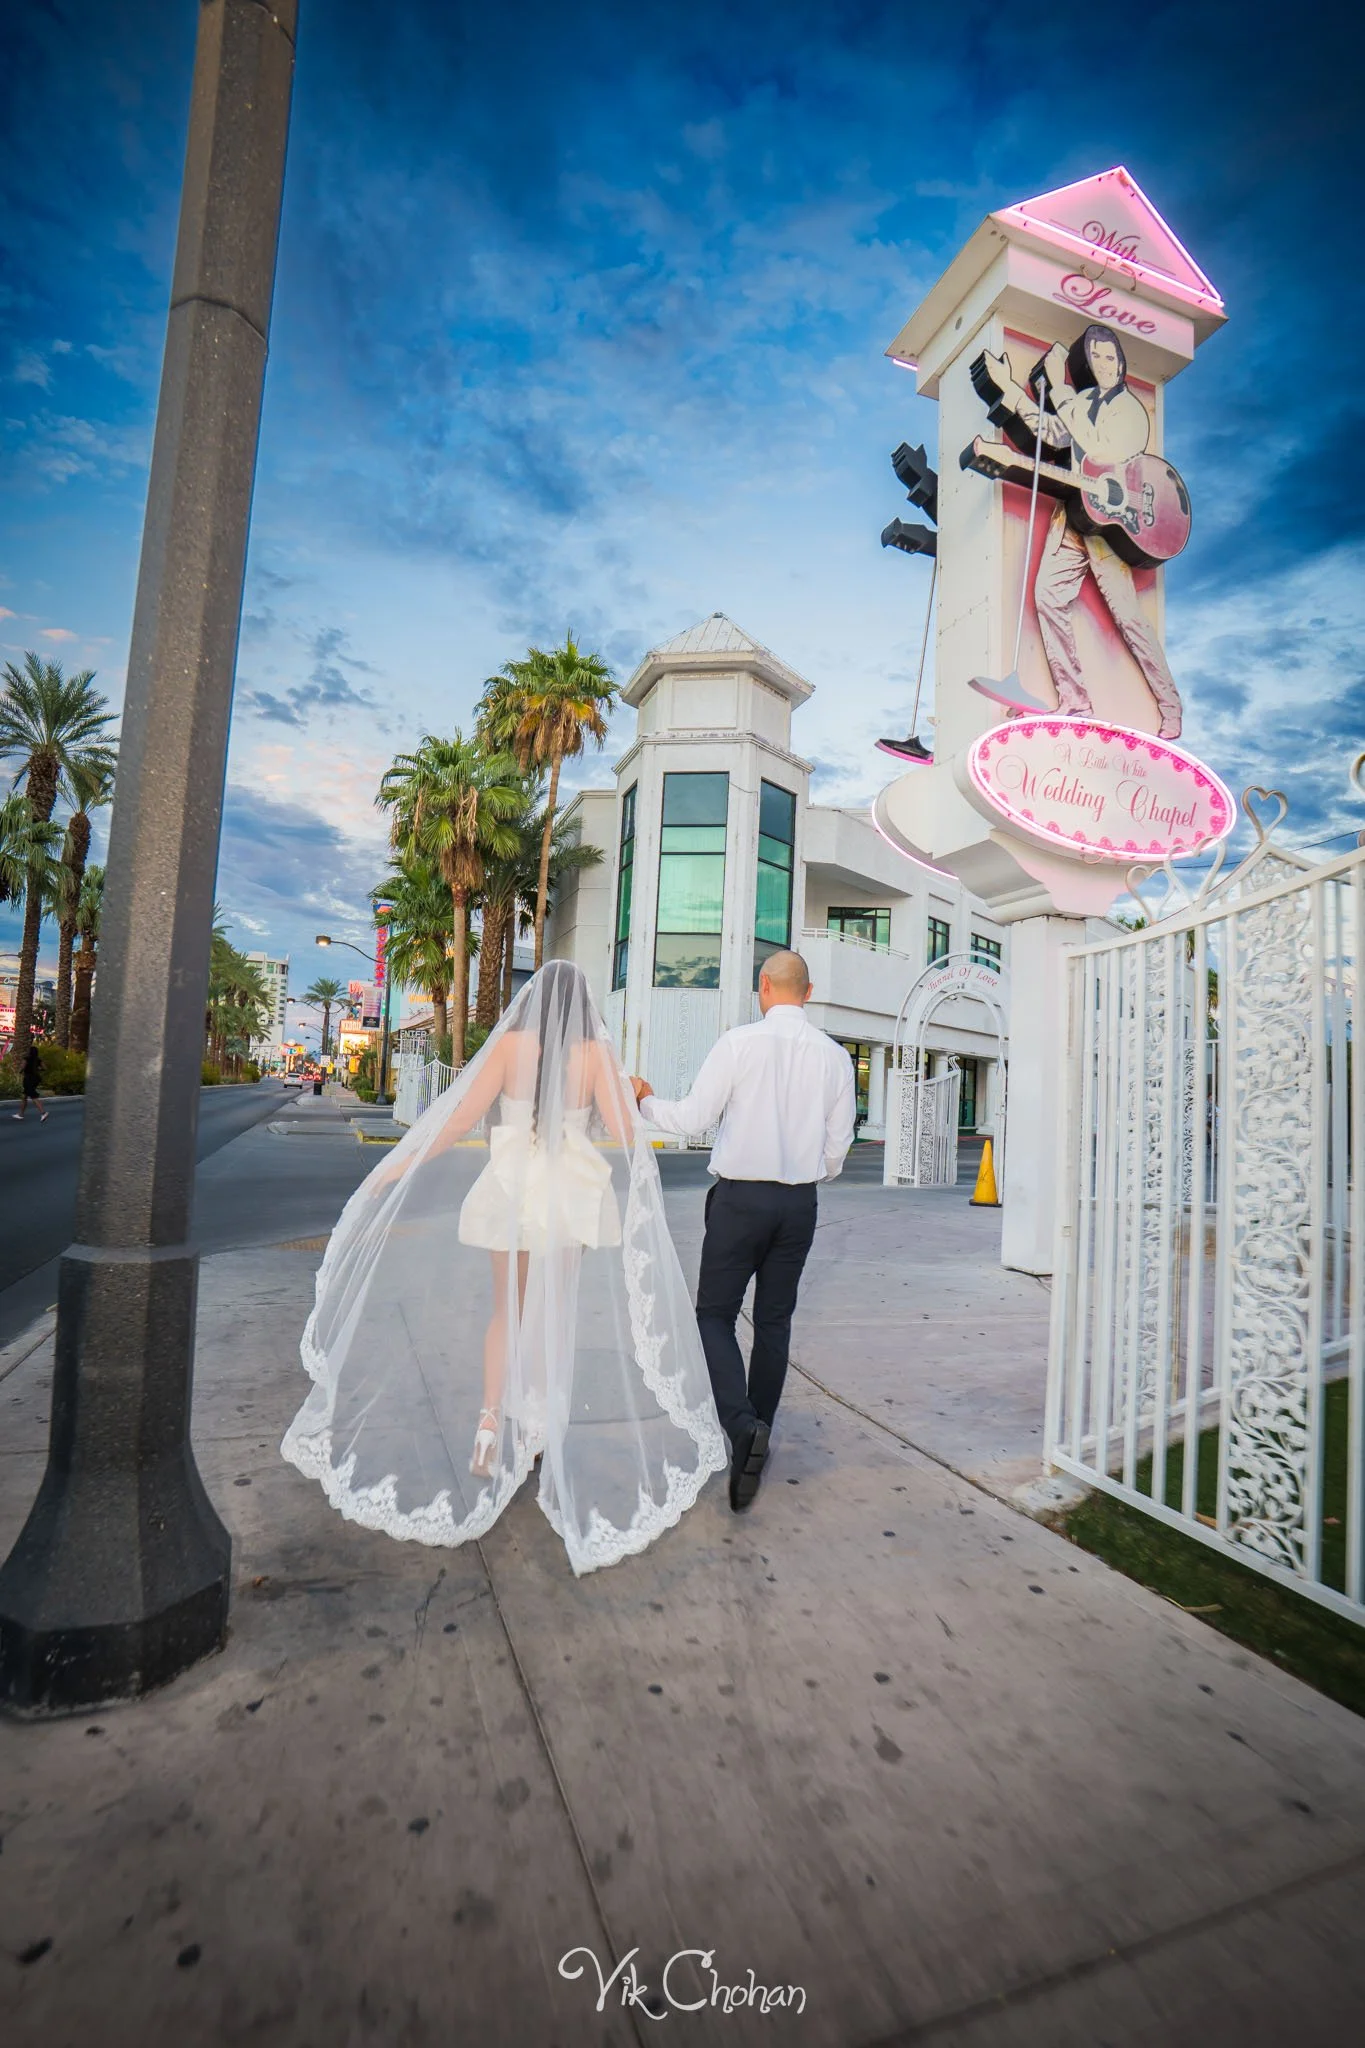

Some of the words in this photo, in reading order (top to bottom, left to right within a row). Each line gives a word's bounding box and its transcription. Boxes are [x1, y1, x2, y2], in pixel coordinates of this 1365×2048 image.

[1082, 220, 1142, 264] With
[1052, 273, 1157, 334] Love
[1053, 743, 1072, 765] A
[1078, 746, 1110, 770] Little
[1112, 754, 1148, 778] White
[996, 754, 1107, 823] Wedding
[1115, 779, 1198, 836] Chapel
[927, 967, 955, 992] Tunnel
[959, 965, 974, 980] Of
[976, 969, 998, 987] Love
